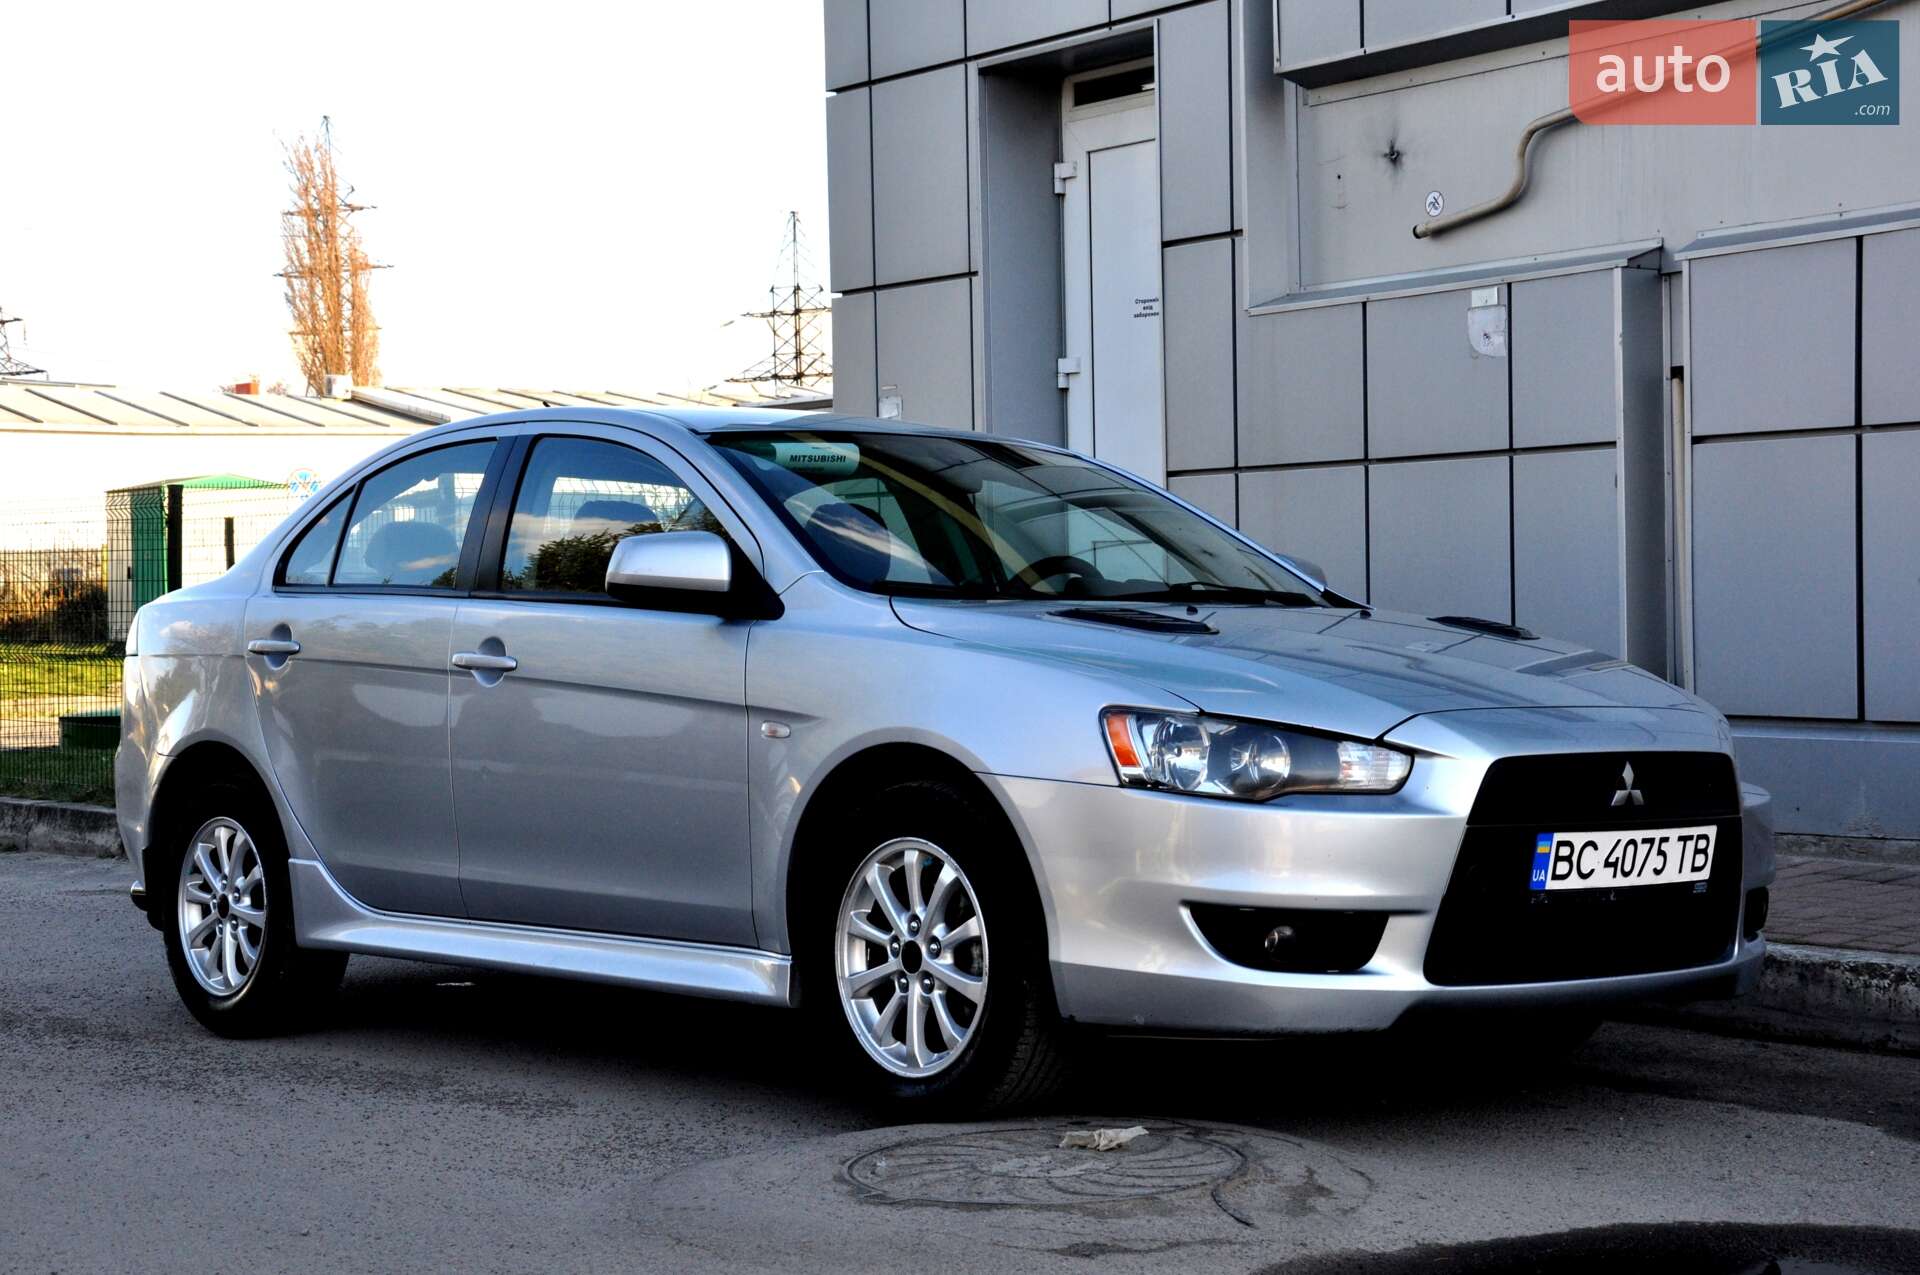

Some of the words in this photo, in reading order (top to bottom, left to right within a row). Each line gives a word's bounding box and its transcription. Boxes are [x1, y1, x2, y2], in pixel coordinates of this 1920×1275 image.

[789, 454, 846, 462] MITSUBISHI
[1551, 840, 1599, 881] BC
[1603, 836, 1670, 879] 4075
[1677, 833, 1710, 875] TB
[1532, 870, 1546, 882] UA
